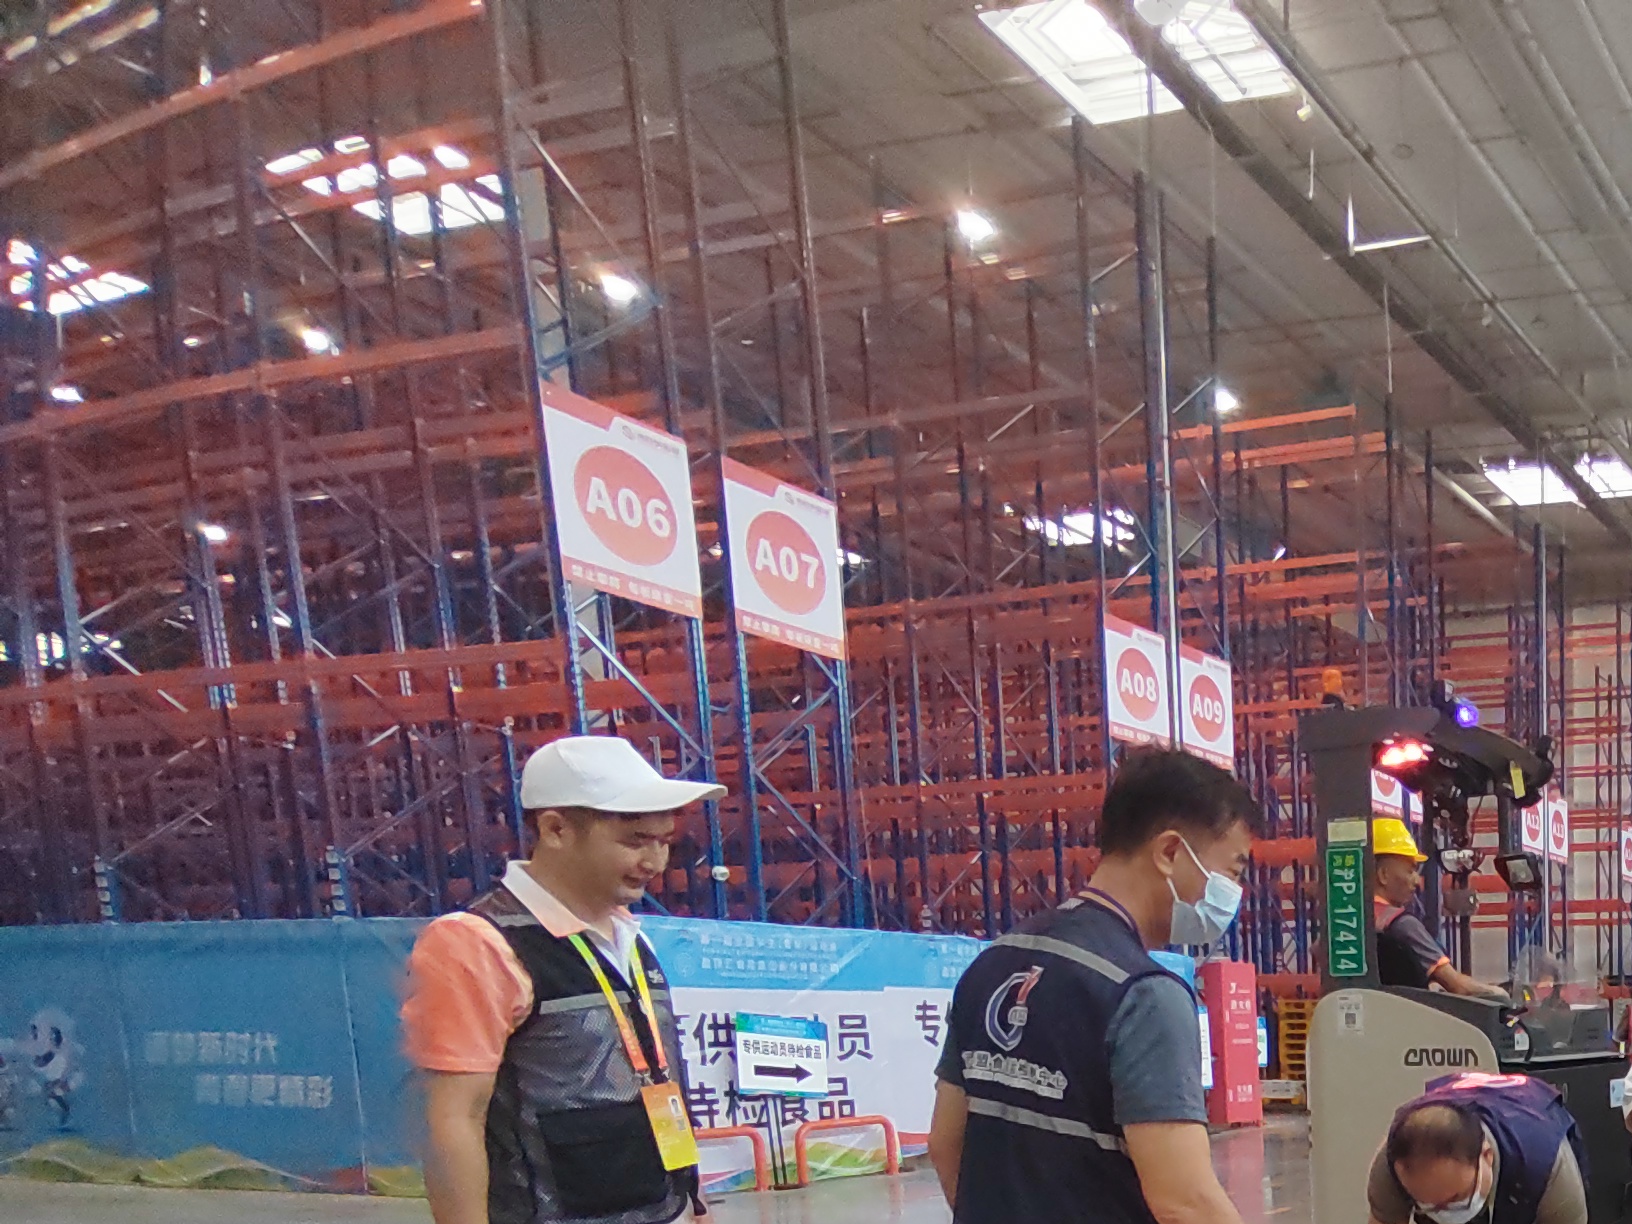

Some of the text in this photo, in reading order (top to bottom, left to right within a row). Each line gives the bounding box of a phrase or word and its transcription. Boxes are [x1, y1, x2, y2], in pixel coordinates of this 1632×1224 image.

[586, 476, 671, 538] A06
[755, 538, 819, 589] A07
[1120, 668, 1157, 702] A08
[1192, 693, 1223, 724] A09
[1403, 1048, 1479, 1067] CROWN
